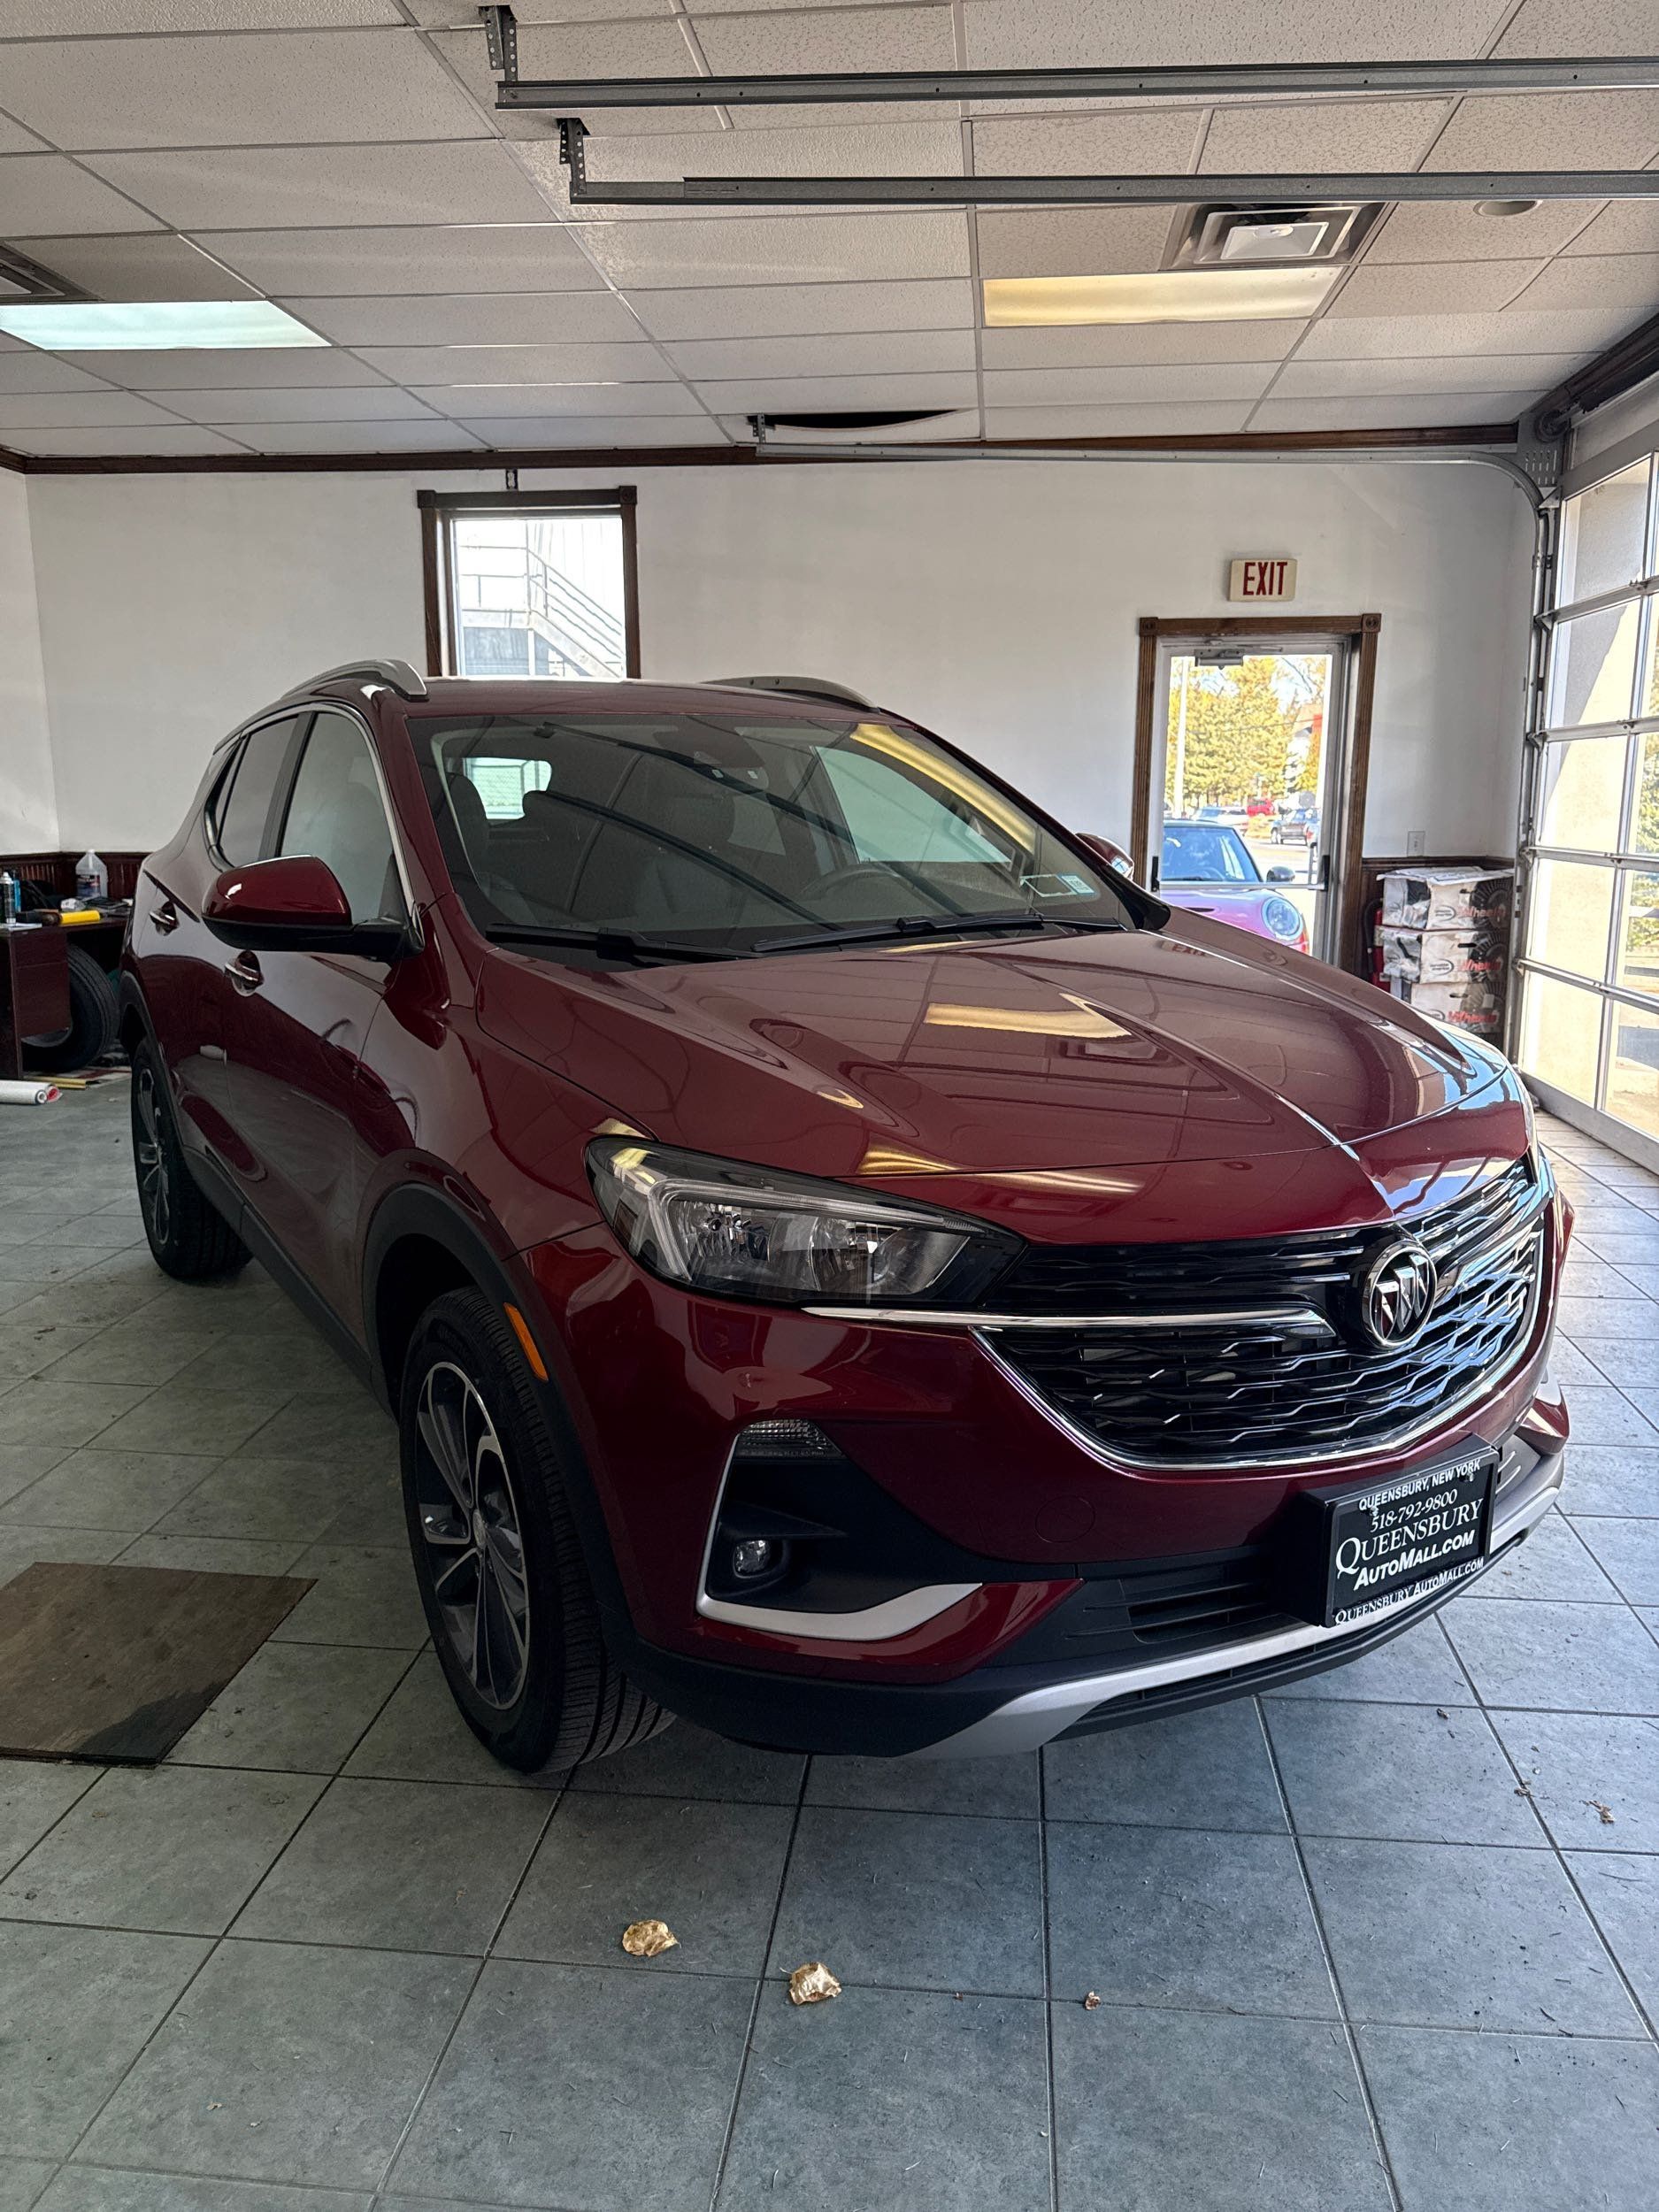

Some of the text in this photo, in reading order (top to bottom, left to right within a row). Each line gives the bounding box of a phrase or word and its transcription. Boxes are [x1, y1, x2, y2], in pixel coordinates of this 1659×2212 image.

[1243, 562, 1287, 595] EXIT
[1359, 1459, 1481, 1511] QUEENSBURY, NEW YORK
[1371, 1488, 1458, 1533] 518-792-9800
[1335, 1498, 1483, 1579] QUEENSBURY
[1334, 1586, 1412, 1625] QUEENSBURY
